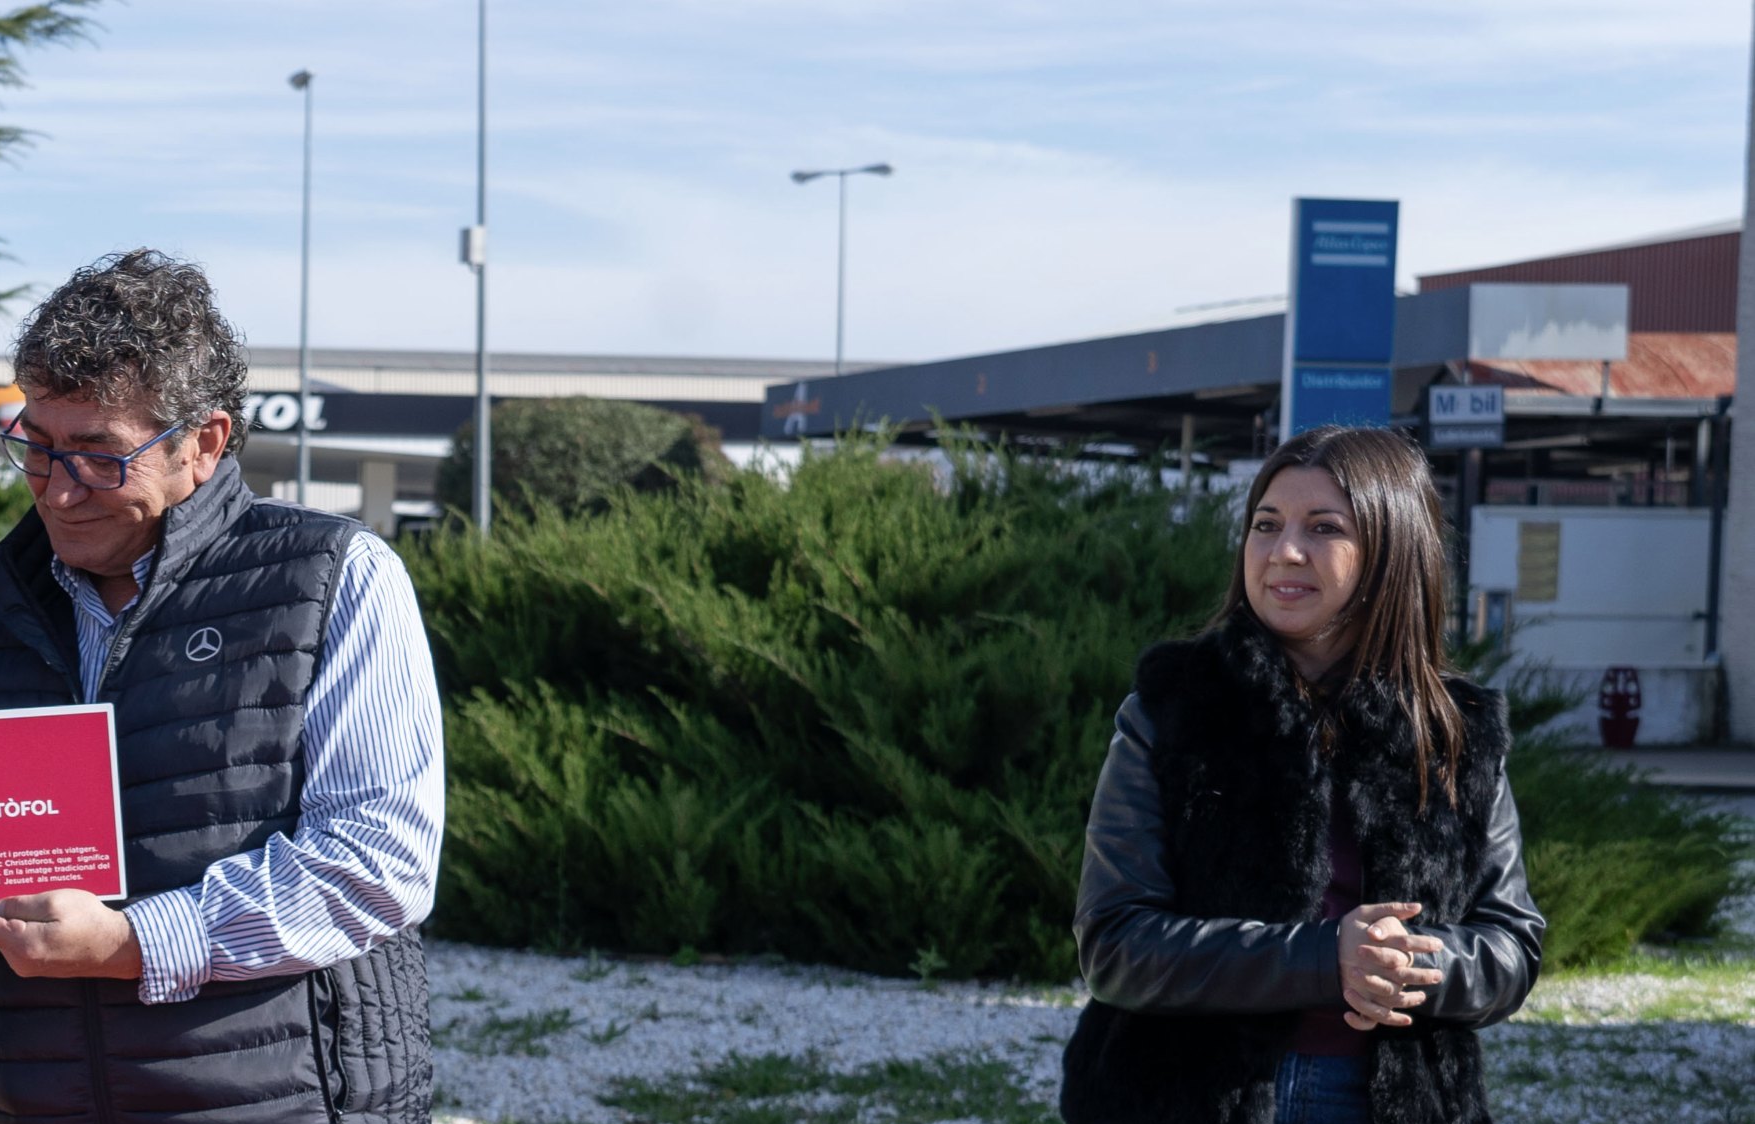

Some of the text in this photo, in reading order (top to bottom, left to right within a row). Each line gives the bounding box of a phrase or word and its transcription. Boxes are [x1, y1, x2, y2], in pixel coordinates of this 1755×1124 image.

[1436, 392, 1496, 414] Mbil
[13, 848, 50, 858] protegeix
[77, 853, 110, 863] significa
[3, 868, 14, 876] En
[25, 866, 52, 874] imatge
[54, 863, 95, 872] tradicional
[4, 877, 34, 885] Jesuset
[50, 873, 83, 881] muscles.
